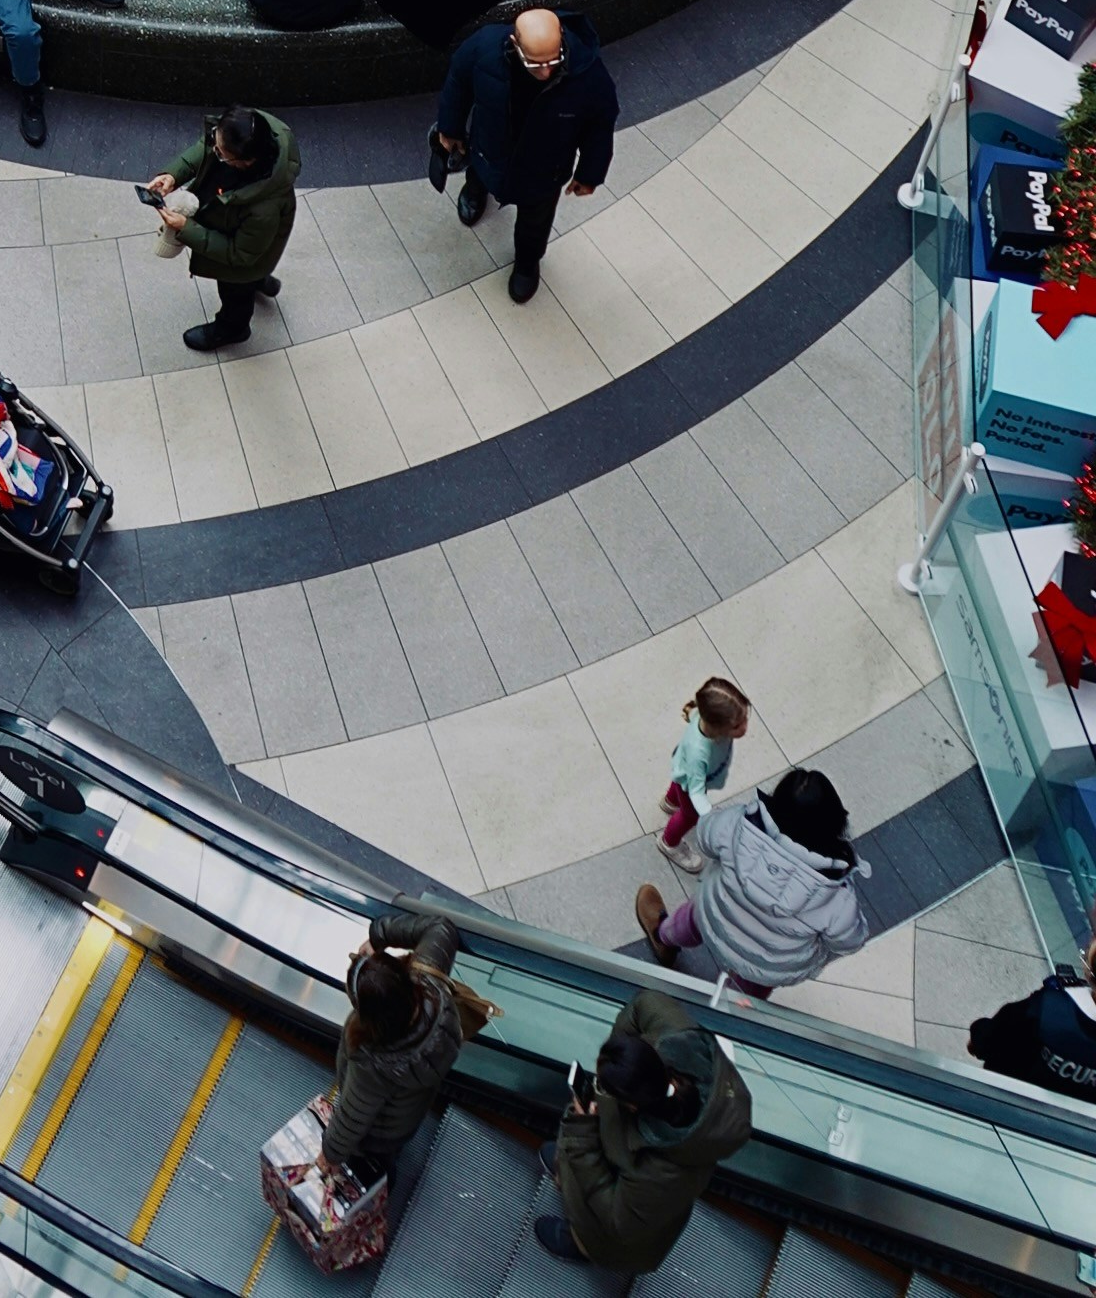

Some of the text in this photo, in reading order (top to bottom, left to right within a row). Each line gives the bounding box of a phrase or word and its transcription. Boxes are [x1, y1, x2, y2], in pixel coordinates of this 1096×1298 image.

[1025, 170, 1055, 232] PayPal
[990, 419, 1018, 433] No
[995, 408, 1024, 422] No
[985, 429, 1047, 454] Period.
[9, 751, 65, 790] Level
[29, 776, 44, 798] 1
